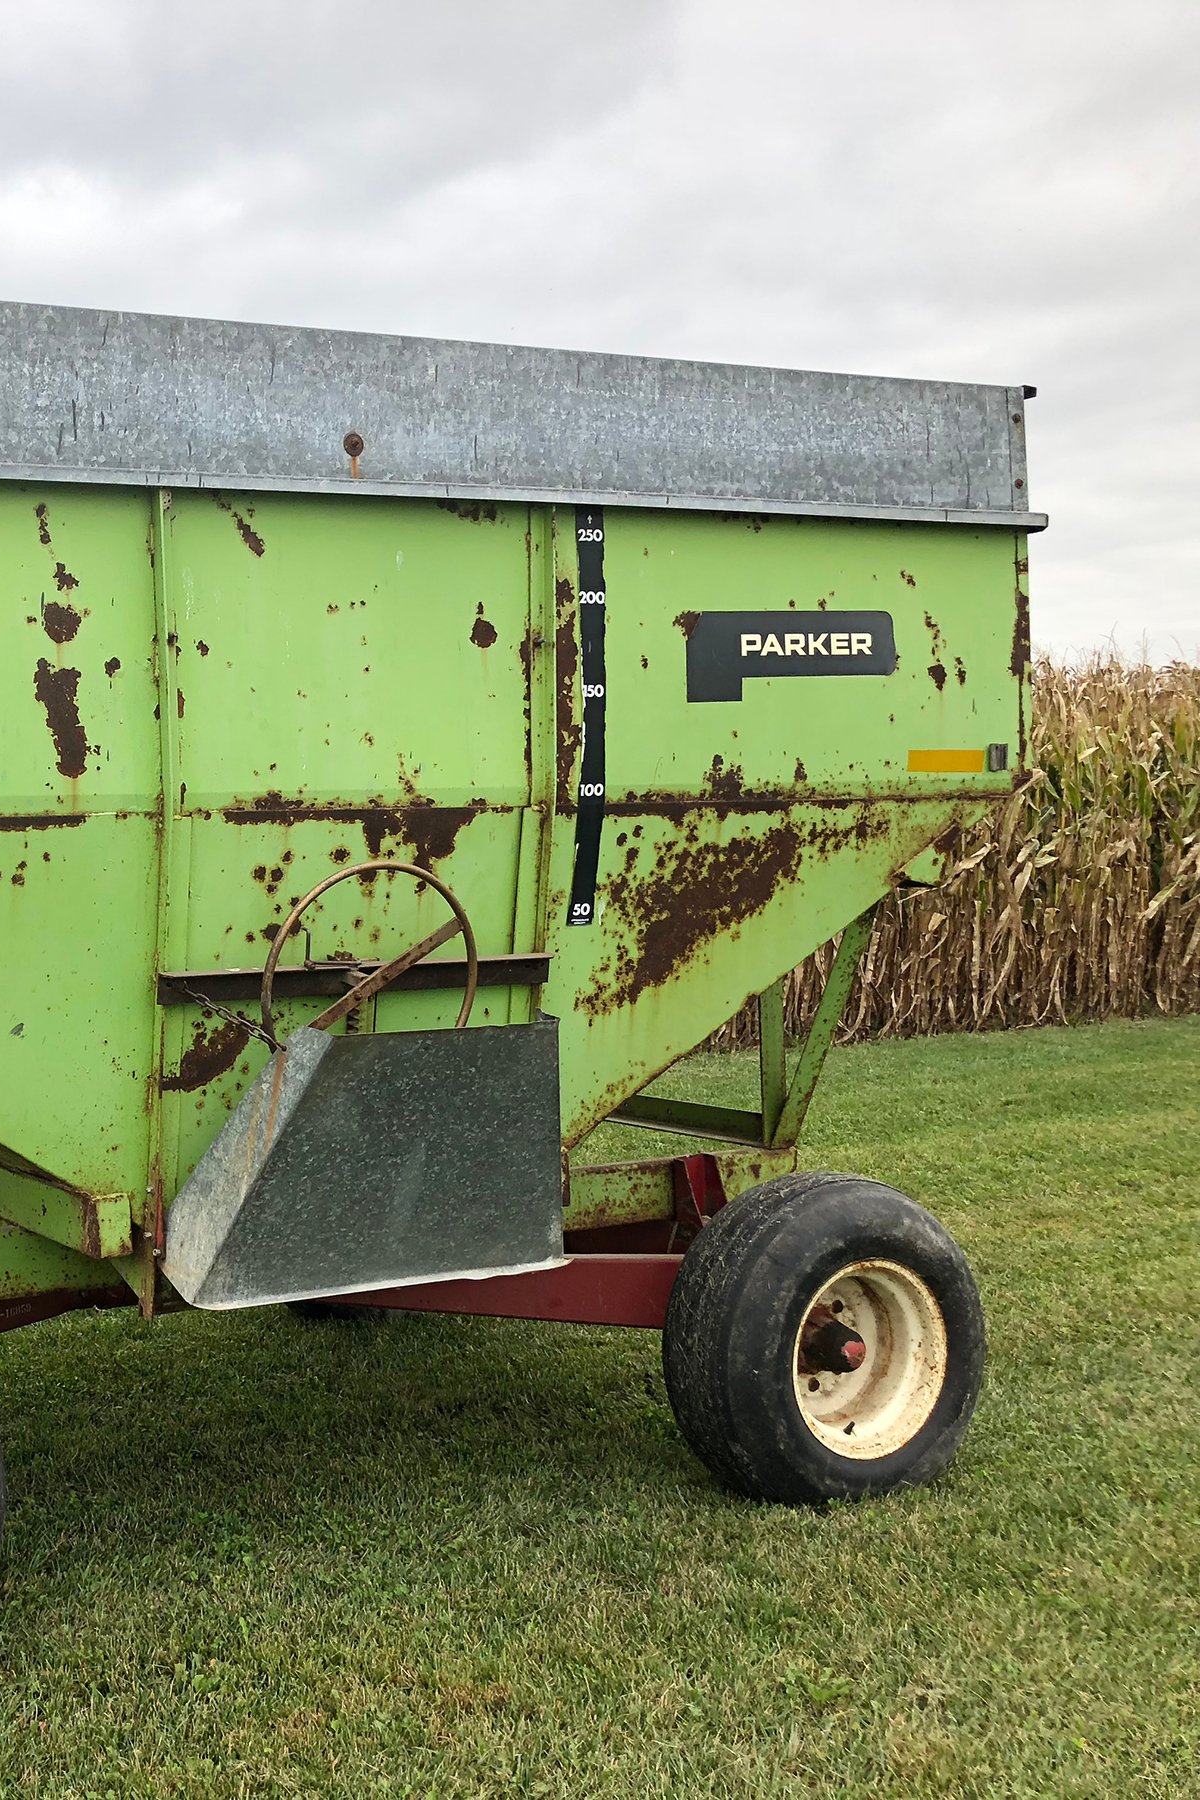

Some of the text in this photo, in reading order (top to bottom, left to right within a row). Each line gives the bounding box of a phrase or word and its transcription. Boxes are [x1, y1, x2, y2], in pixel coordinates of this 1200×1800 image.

[577, 528, 604, 542] 250
[578, 590, 605, 605] 200
[740, 632, 873, 657] PARKER
[582, 683, 605, 698] 150
[580, 783, 604, 797] 100
[572, 902, 591, 917] 50
